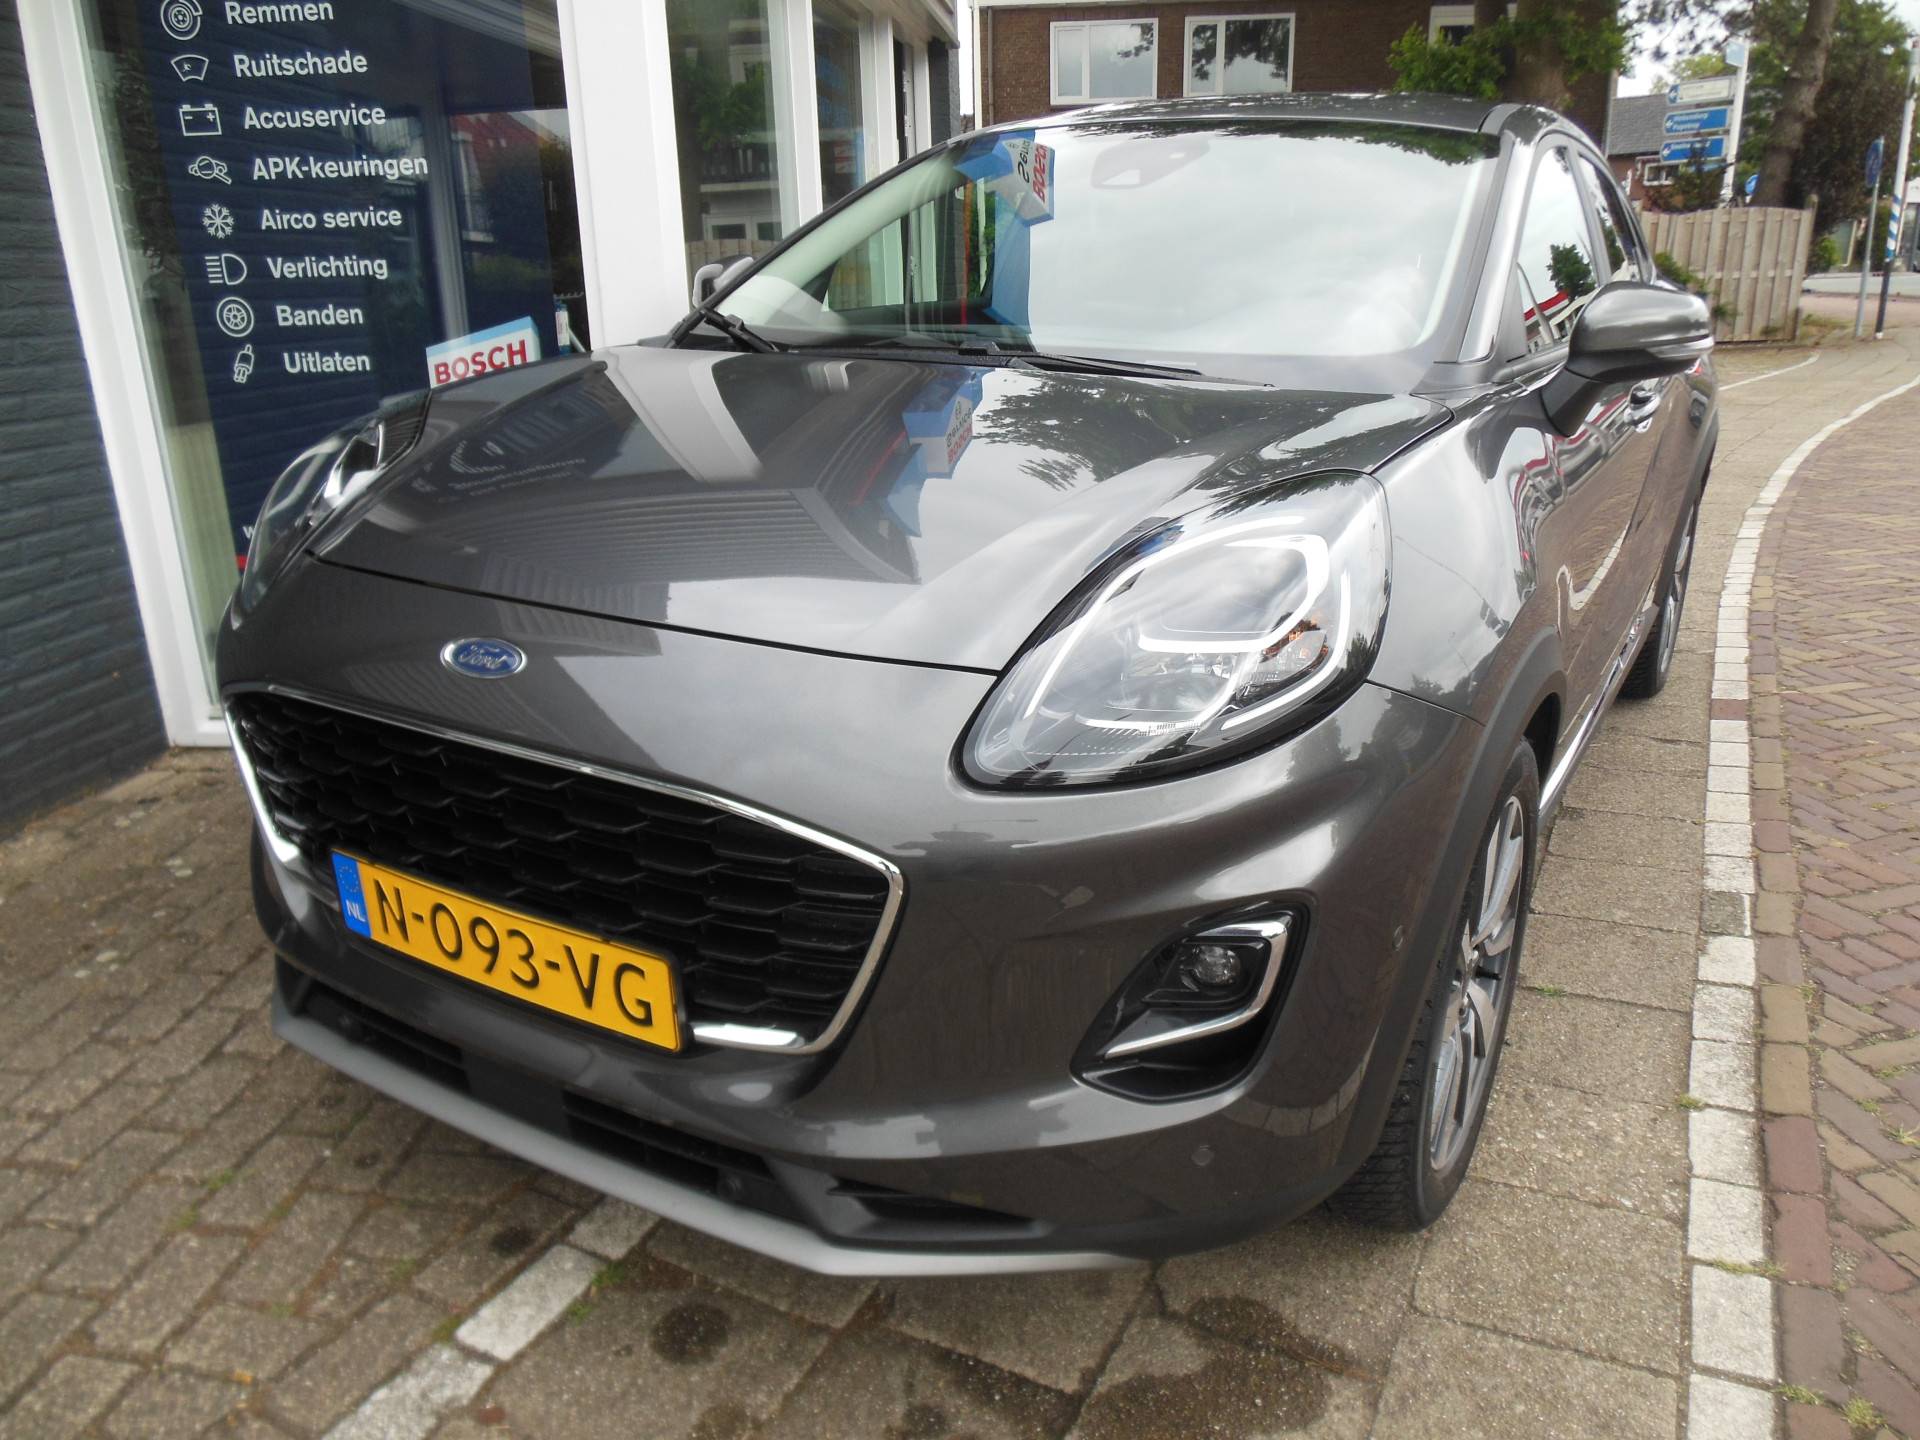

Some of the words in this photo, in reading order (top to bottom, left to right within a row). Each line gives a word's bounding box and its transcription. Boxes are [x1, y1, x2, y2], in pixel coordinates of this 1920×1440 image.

[225, 1, 334, 24] Remmen
[233, 50, 368, 77] Ruitschade
[244, 103, 387, 130] Accuservice
[253, 155, 429, 180] APK-keuringen
[261, 209, 317, 230] Airco
[323, 206, 402, 228] service
[266, 255, 388, 280] Verlichting
[275, 304, 363, 326] Banden
[283, 352, 371, 373] Uitlaten
[434, 339, 528, 384] BOSCH
[458, 644, 508, 670] Ford
[346, 900, 367, 922] NL
[373, 879, 654, 1028] N-093-VG
